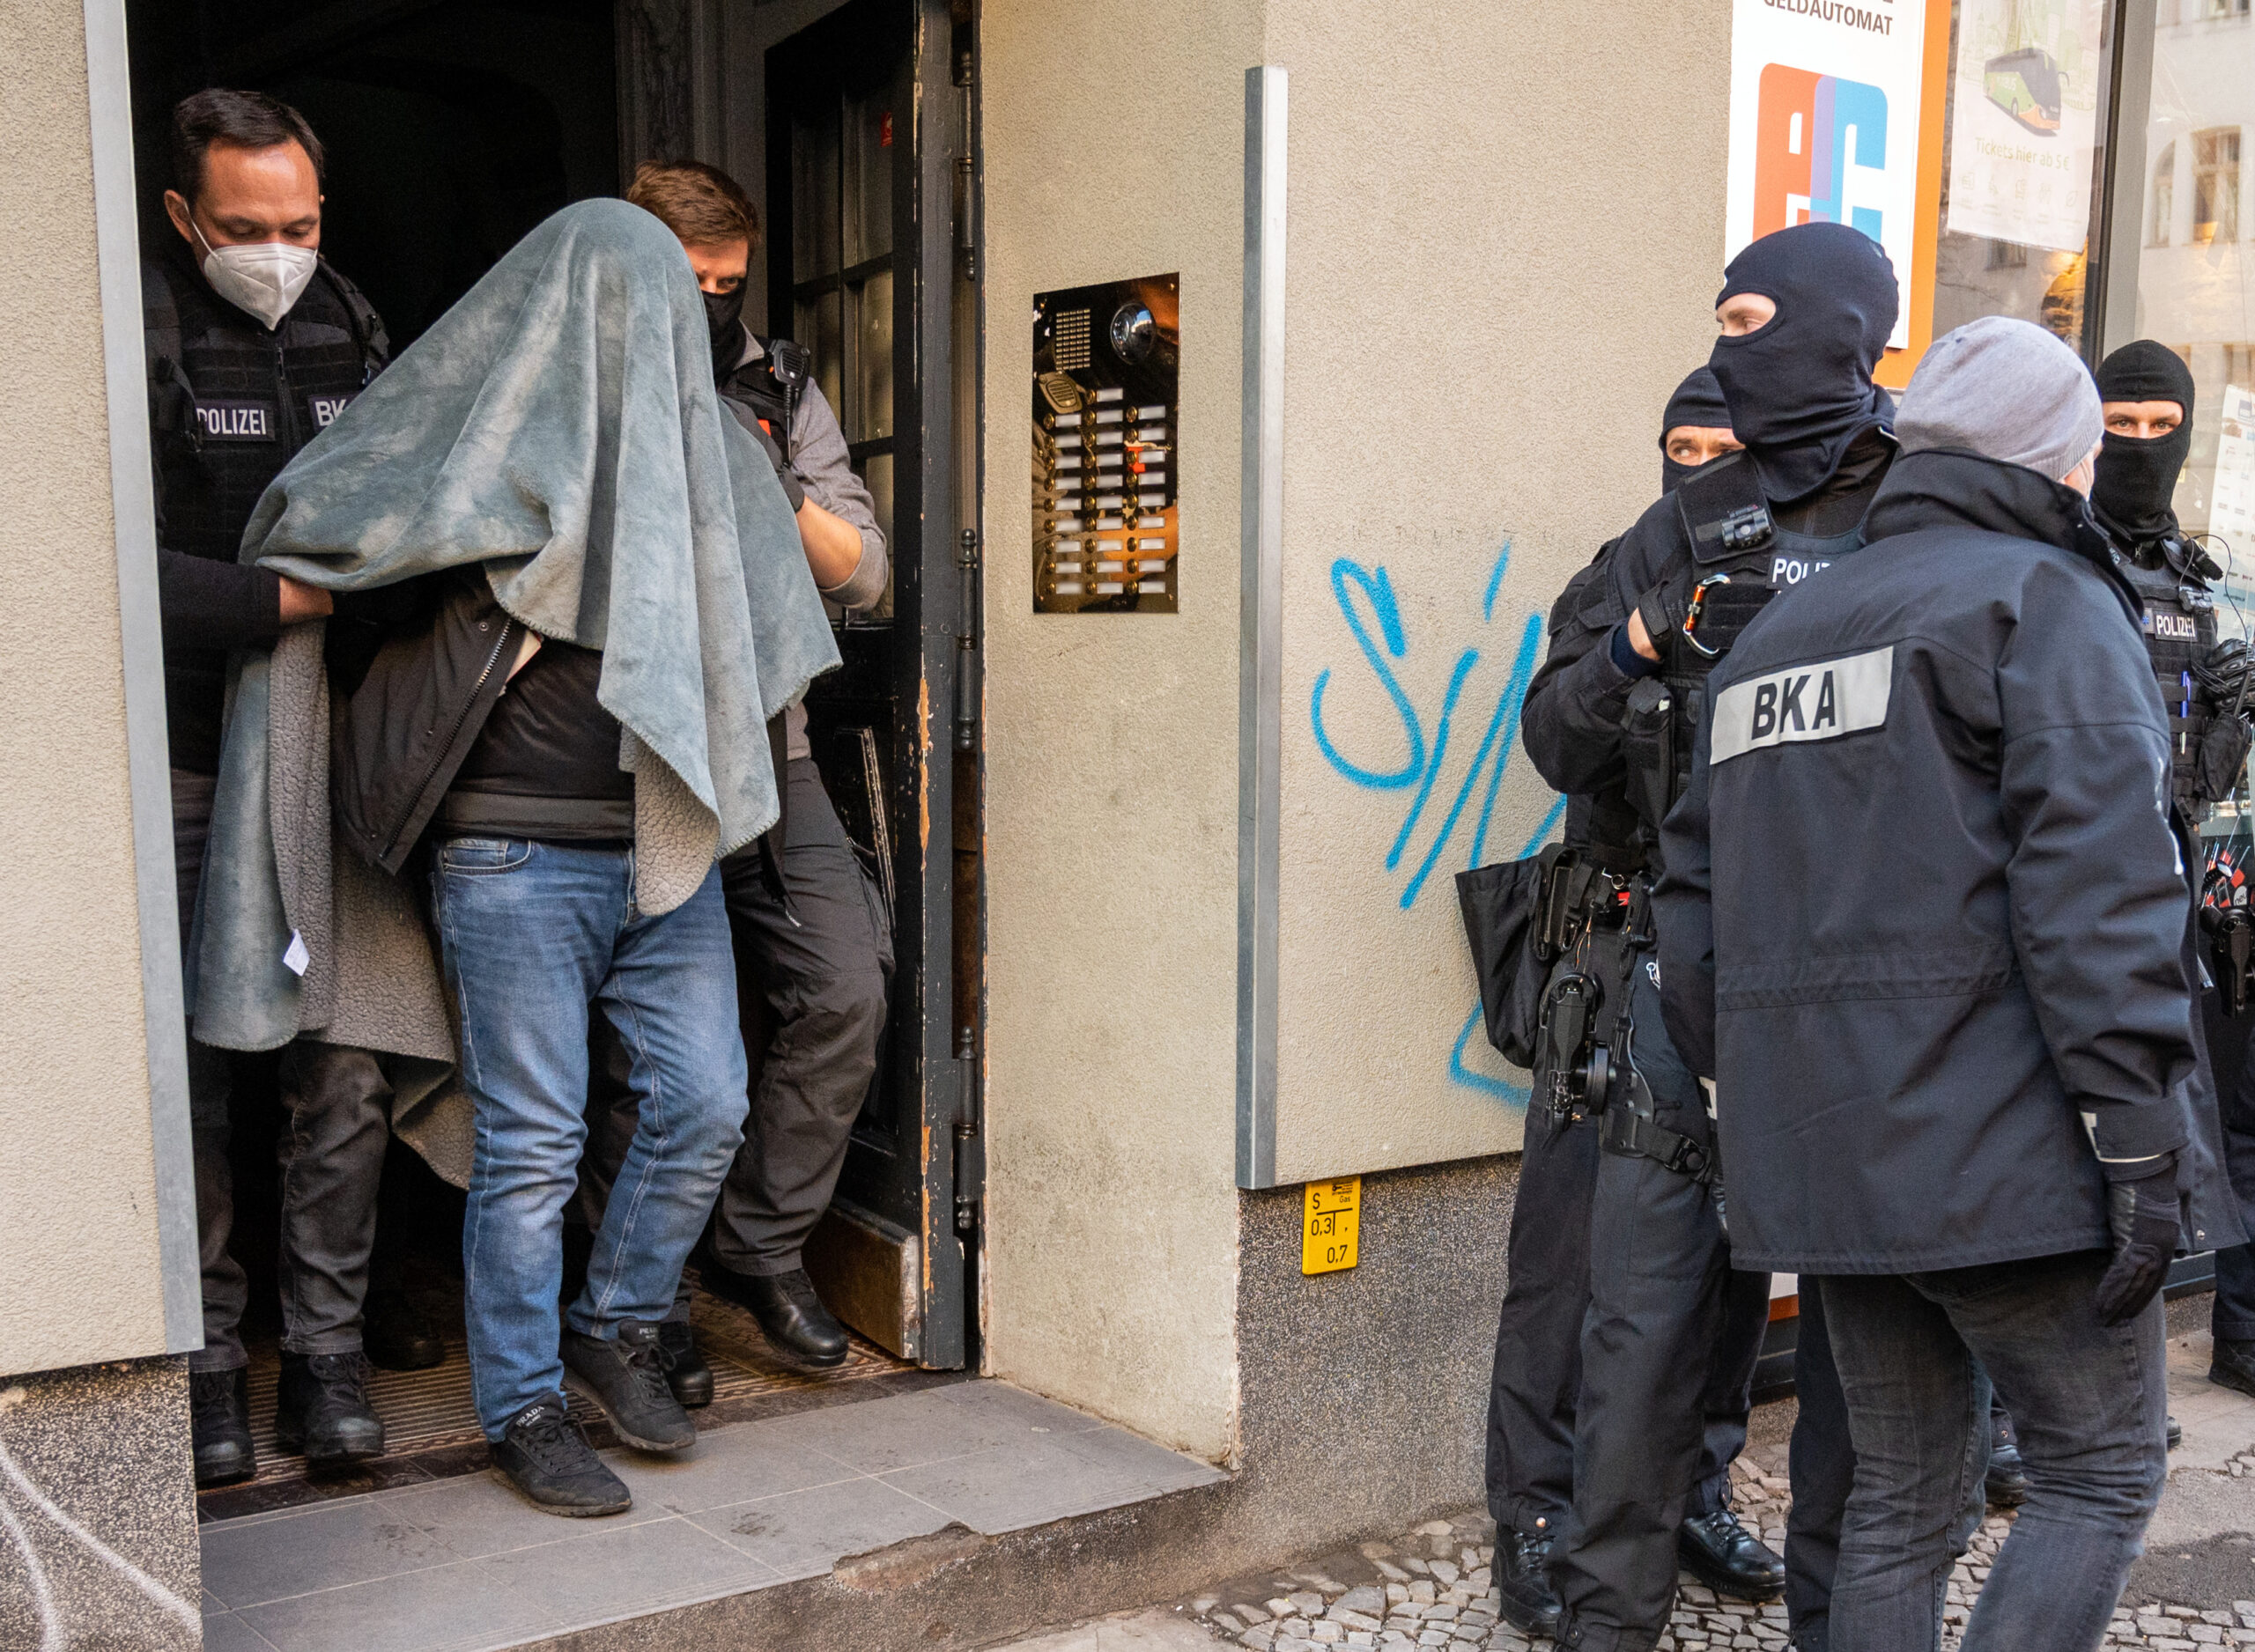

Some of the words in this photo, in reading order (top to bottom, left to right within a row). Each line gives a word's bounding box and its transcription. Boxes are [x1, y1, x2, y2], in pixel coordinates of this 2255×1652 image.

[1975, 136, 2014, 159] Tickets
[2015, 144, 2037, 164] hier
[2039, 151, 2053, 167] ab
[196, 408, 267, 435] POLIZEI
[314, 399, 347, 426] BK
[2155, 615, 2196, 638] POLIZEI
[1751, 669, 1837, 741] BKA
[1312, 1192, 1320, 1210] S
[1311, 1217, 1332, 1236] 0,3
[1327, 1244, 1348, 1264] 0,7
[515, 1405, 545, 1427] PRADA
